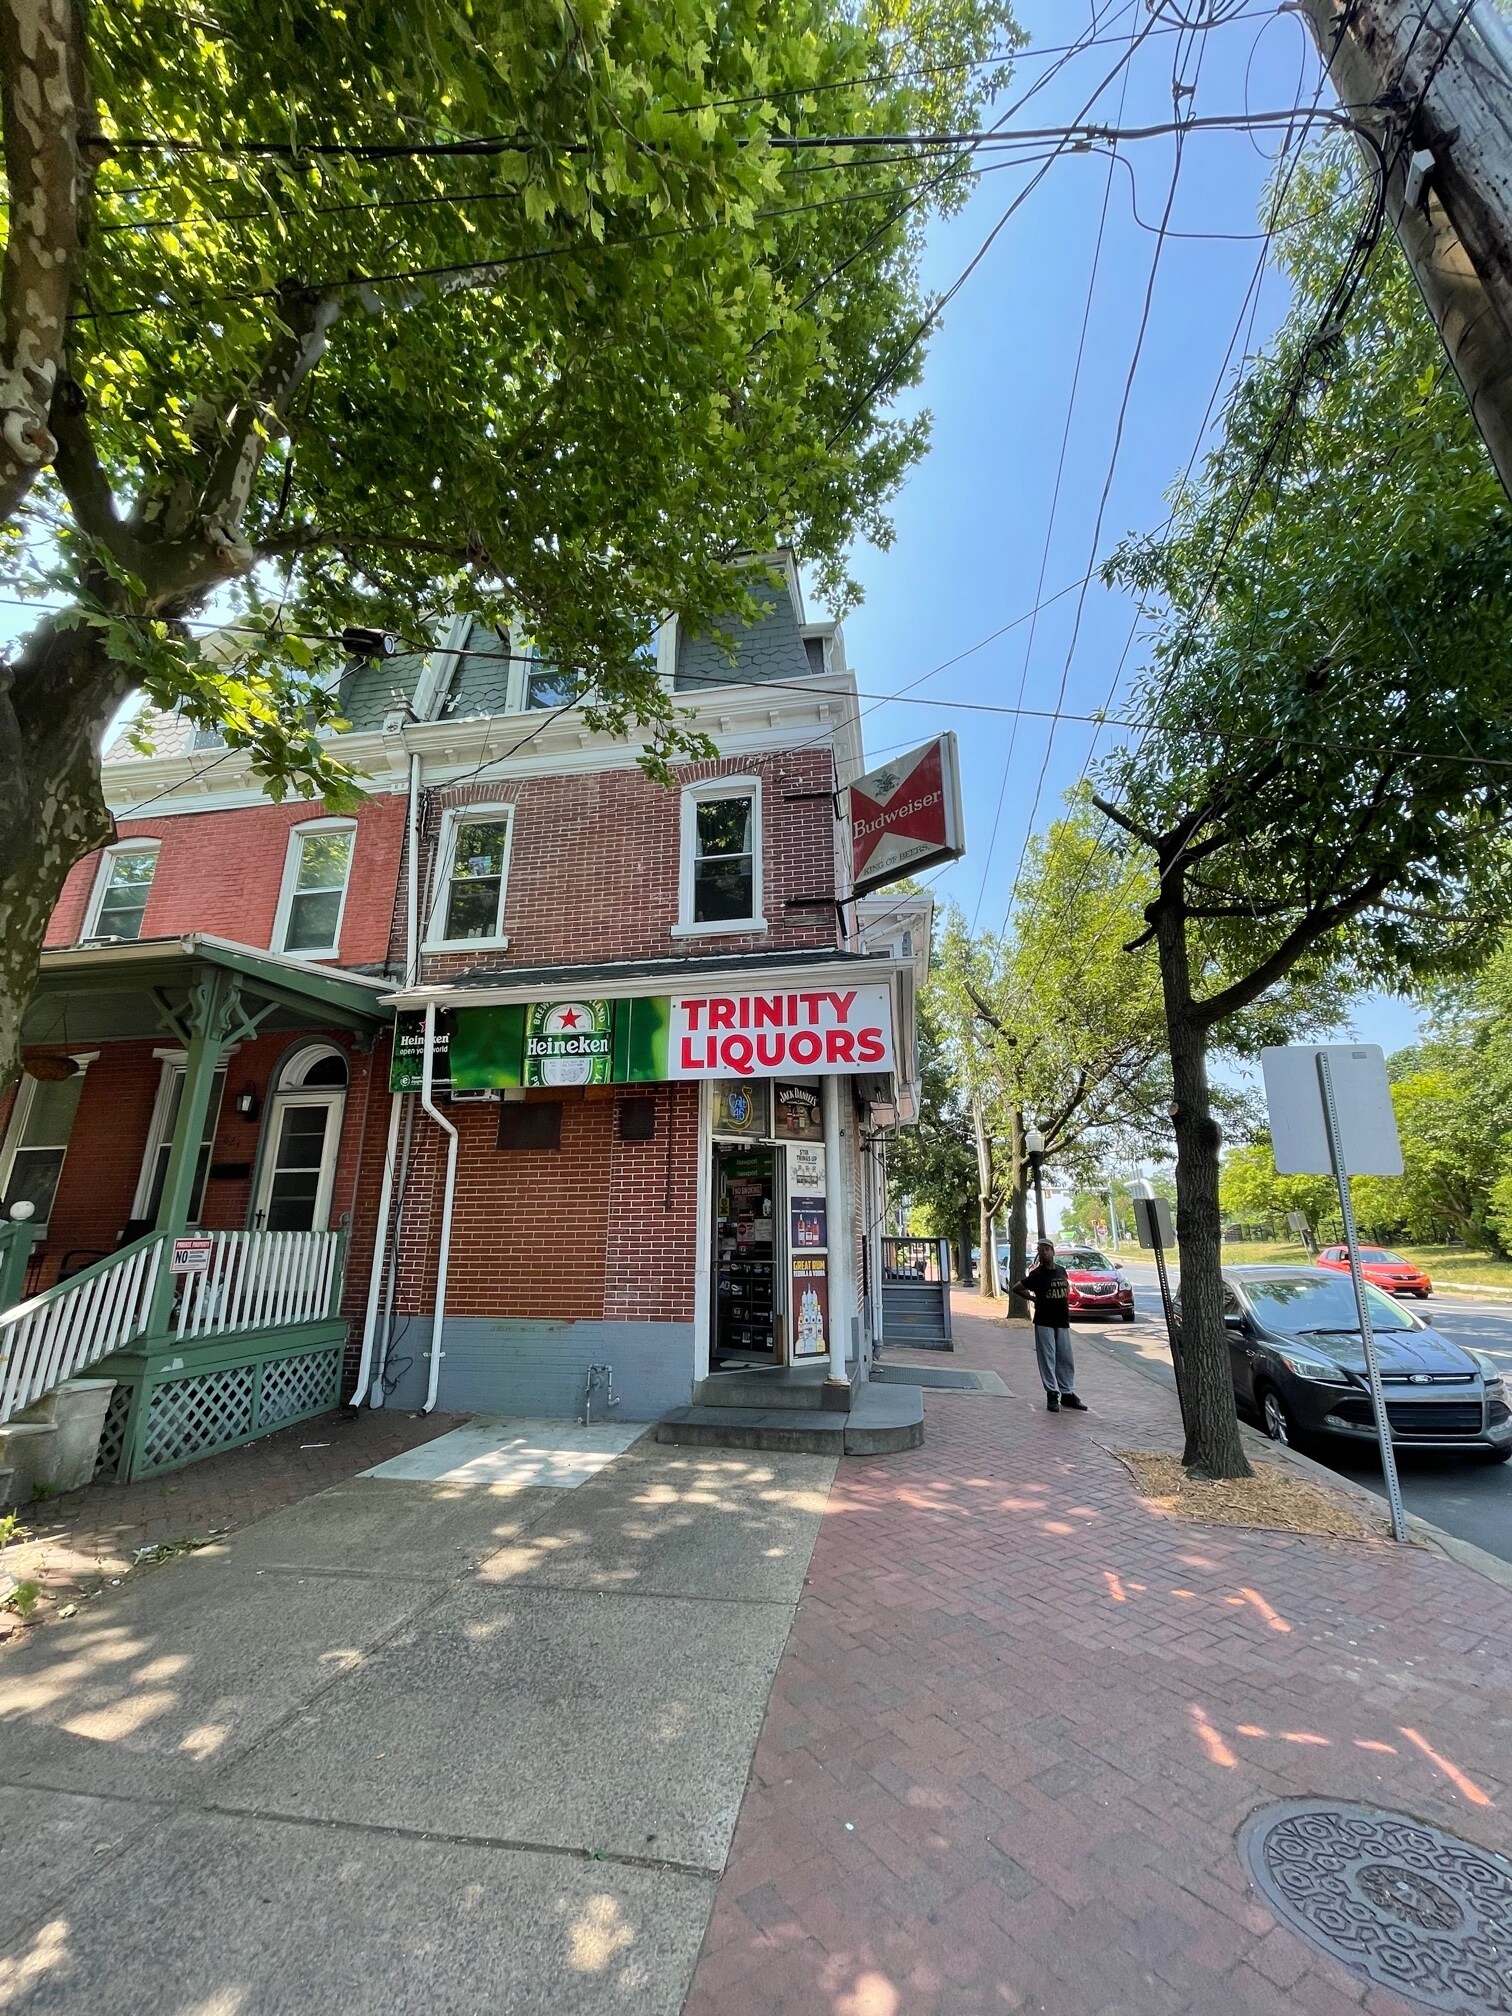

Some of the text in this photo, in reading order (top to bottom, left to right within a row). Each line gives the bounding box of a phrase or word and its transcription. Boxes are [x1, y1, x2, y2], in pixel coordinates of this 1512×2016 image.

[853, 790, 941, 840] Budweiser
[864, 860, 884, 876] KING
[885, 854, 898, 867] OF
[681, 991, 857, 1030] TRINITY
[401, 1034, 450, 1046] Heinen
[527, 1036, 609, 1056] Heineken
[433, 1045, 449, 1053] orld
[681, 1028, 885, 1075] LIQUORS
[780, 1090, 794, 1104] JACK
[175, 1250, 188, 1264] NO
[793, 1261, 825, 1270] GREAT RUM
